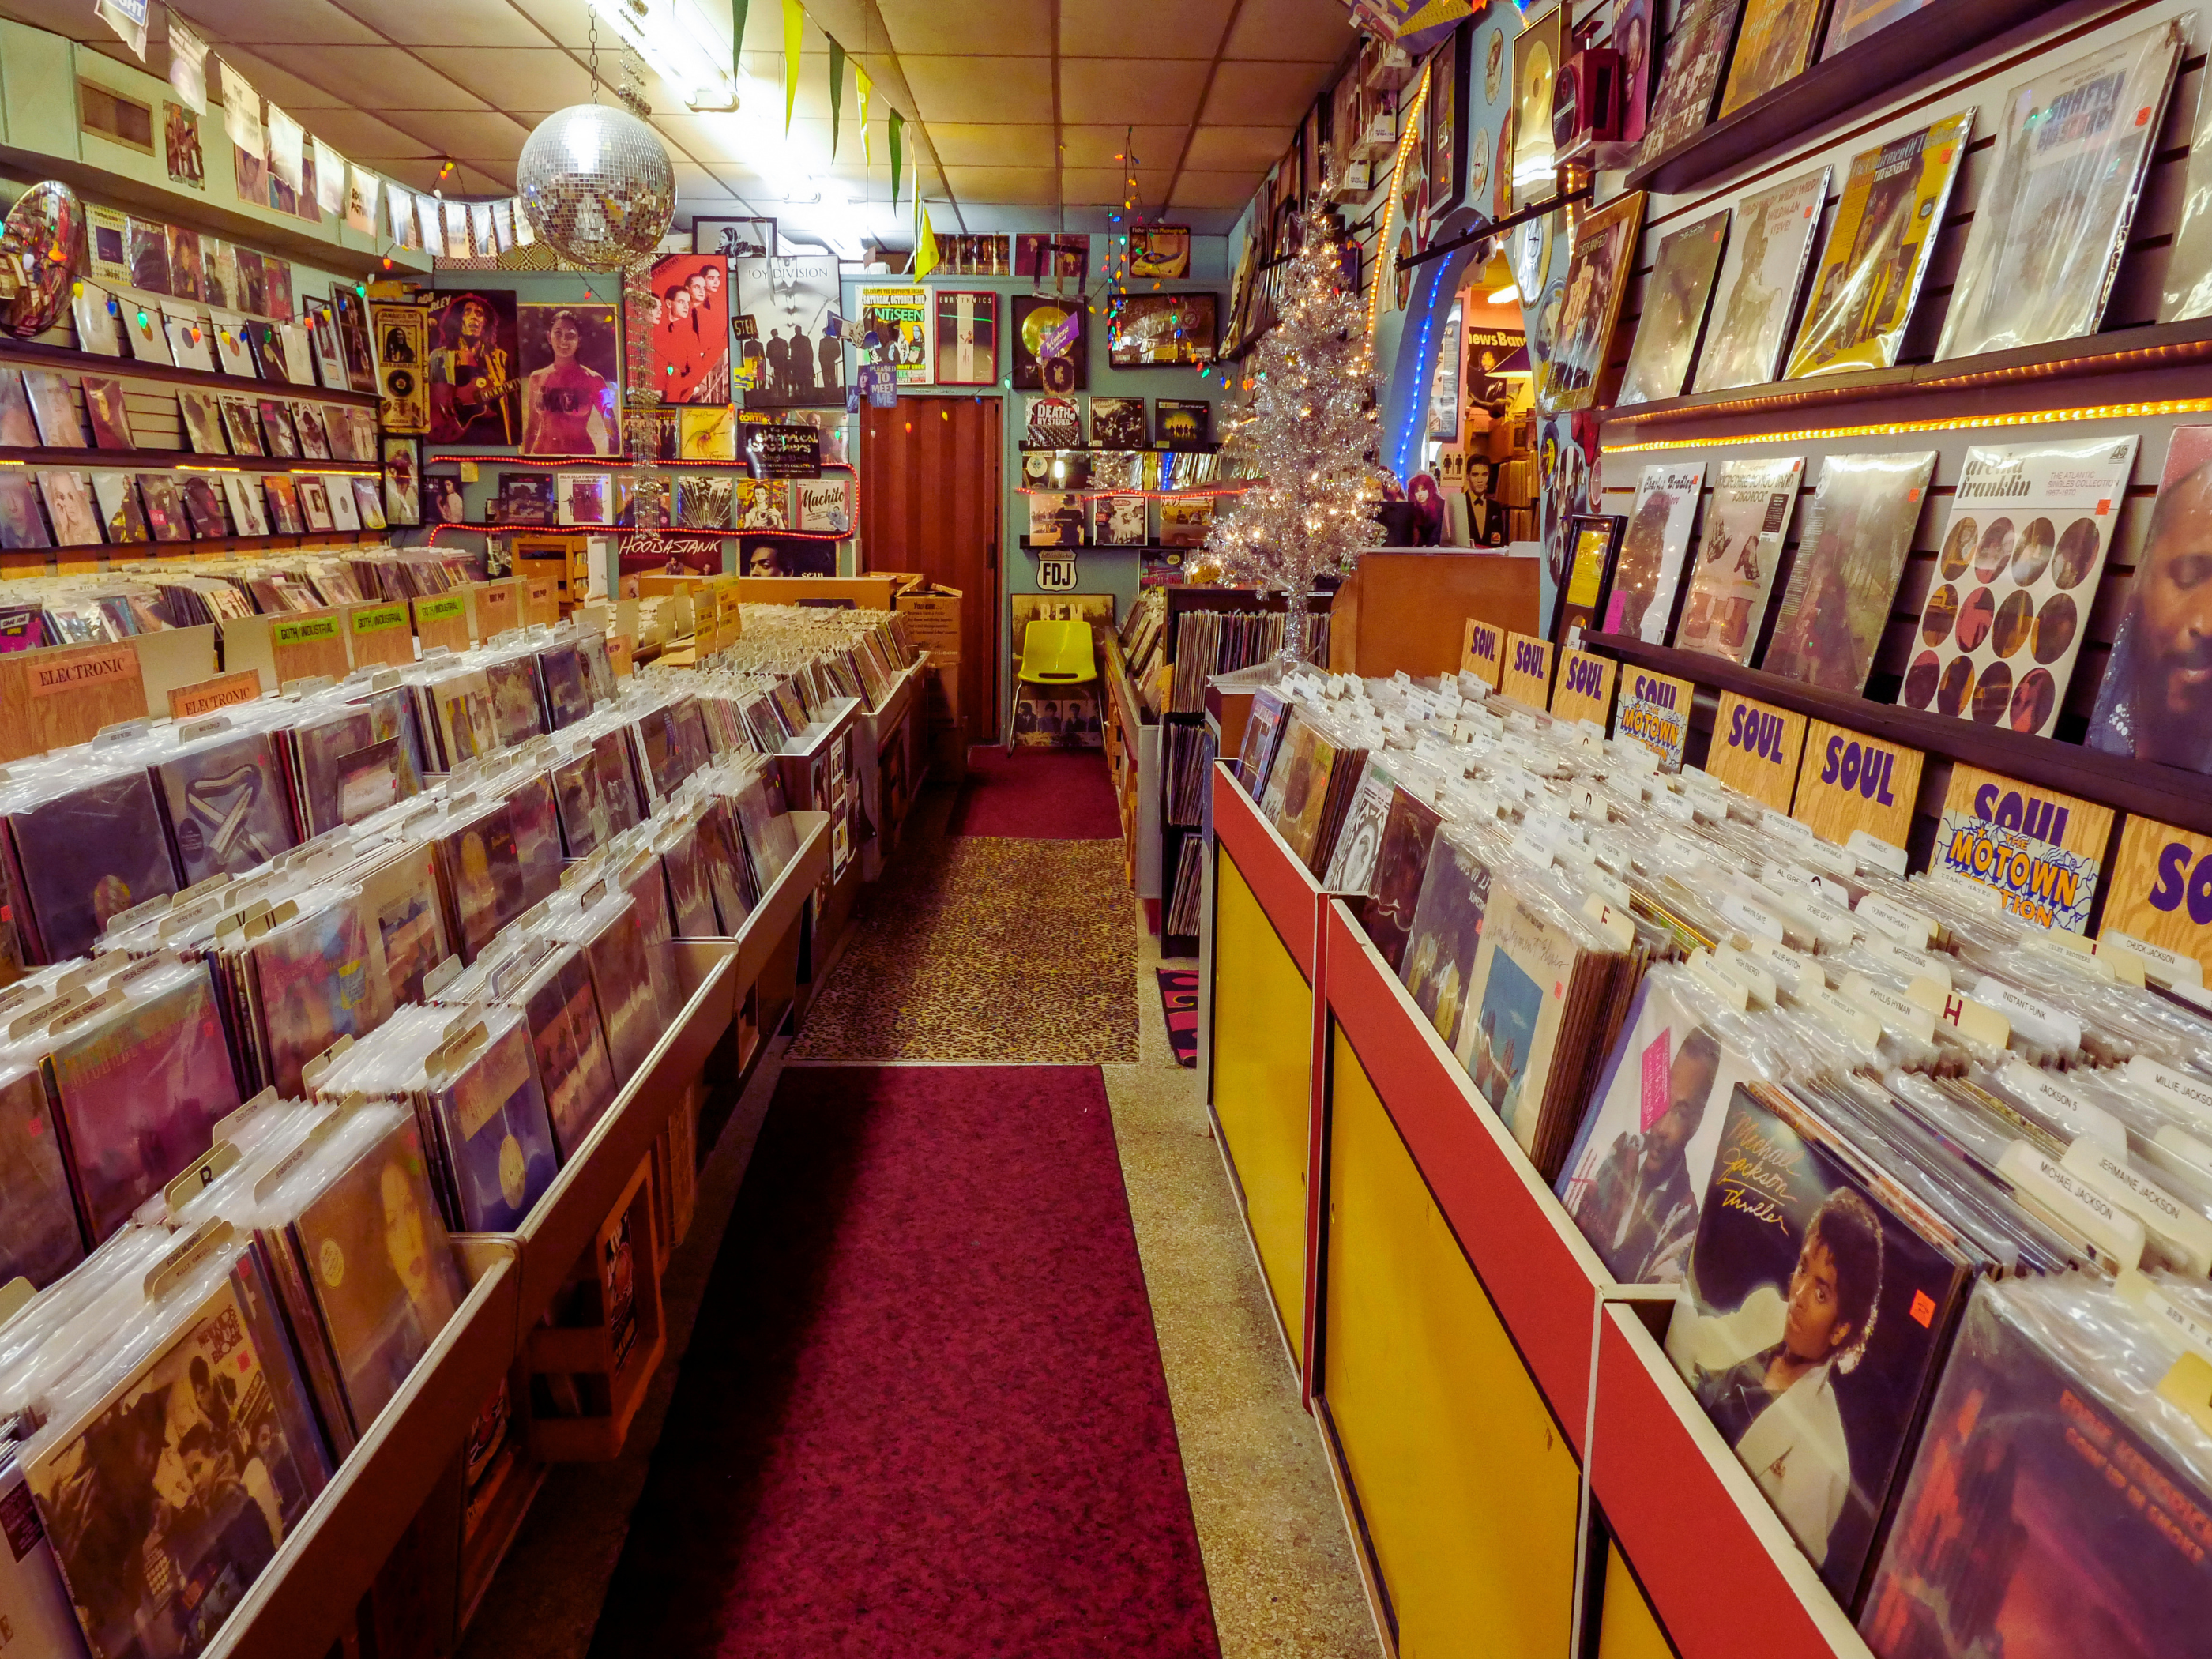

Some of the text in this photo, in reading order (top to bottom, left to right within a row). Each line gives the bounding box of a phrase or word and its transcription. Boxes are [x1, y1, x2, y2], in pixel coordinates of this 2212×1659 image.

[773, 267, 828, 279] DIVISION
[890, 295, 914, 305] OCTOBER
[875, 308, 924, 322] NTiSEEN
[871, 383, 894, 393] MEET
[876, 371, 890, 383] TO
[876, 394, 894, 407] ME
[1037, 404, 1070, 418] DEATH
[2063, 471, 2095, 480] ATLANTIC
[2075, 478, 2120, 487] COLLECTION
[1958, 476, 2031, 499] franklin
[803, 487, 845, 512] Machito
[619, 537, 723, 555] HOOBASTANK
[1043, 563, 1071, 586] FDJ
[281, 623, 333, 641] GOTH/INDUSTRIAL
[1471, 626, 1495, 662] SOUL
[1514, 640, 1544, 680] SOUL
[40, 658, 126, 686] ELECTRONIC
[1566, 656, 1602, 701] SOUL
[185, 687, 250, 715] ELECTRONIC
[1621, 706, 1679, 749] MOTOWN
[1728, 704, 1784, 764] SOUL
[1820, 735, 1894, 807] SOUL
[1866, 839, 1887, 854] FUNKADELIC
[2005, 832, 2028, 851] THE
[1778, 868, 1785, 878] AL
[1947, 830, 2080, 911] MOTOWN
[1941, 873, 1992, 898] ISAAC HAYES
[1958, 871, 2053, 928] TION
[1819, 910, 1833, 924] GRAY
[1872, 906, 1910, 931] DONNY HATHAWAY
[1771, 948, 1801, 970] WILLIE HUTCH
[1893, 946, 1926, 968] IMPRESSIONS
[2065, 950, 2091, 964] BROTHERS
[2126, 939, 2176, 965] CHUCK JACKSON
[1744, 962, 1761, 978] ENERGY
[48, 997, 71, 1015] SIMPSON
[83, 996, 107, 1016] SEMBELLO
[1869, 988, 1911, 1016] PHYLLIS HYMAN
[1943, 994, 1963, 1027] H
[2003, 991, 2046, 1021] INSTANT FUNK
[2155, 1074, 2180, 1092] MILLIE
[2039, 1083, 2078, 1112] JACKSON 5
[1728, 1112, 1804, 1177] Michael
[1717, 1148, 1798, 1202] Jackson
[2040, 1161, 2114, 1221] MICHAEL JACKSON
[2098, 1157, 2180, 1220] JERMAINE JACKSON
[1722, 1188, 1790, 1238] Thriller
[166, 1251, 182, 1267] EDDIE
